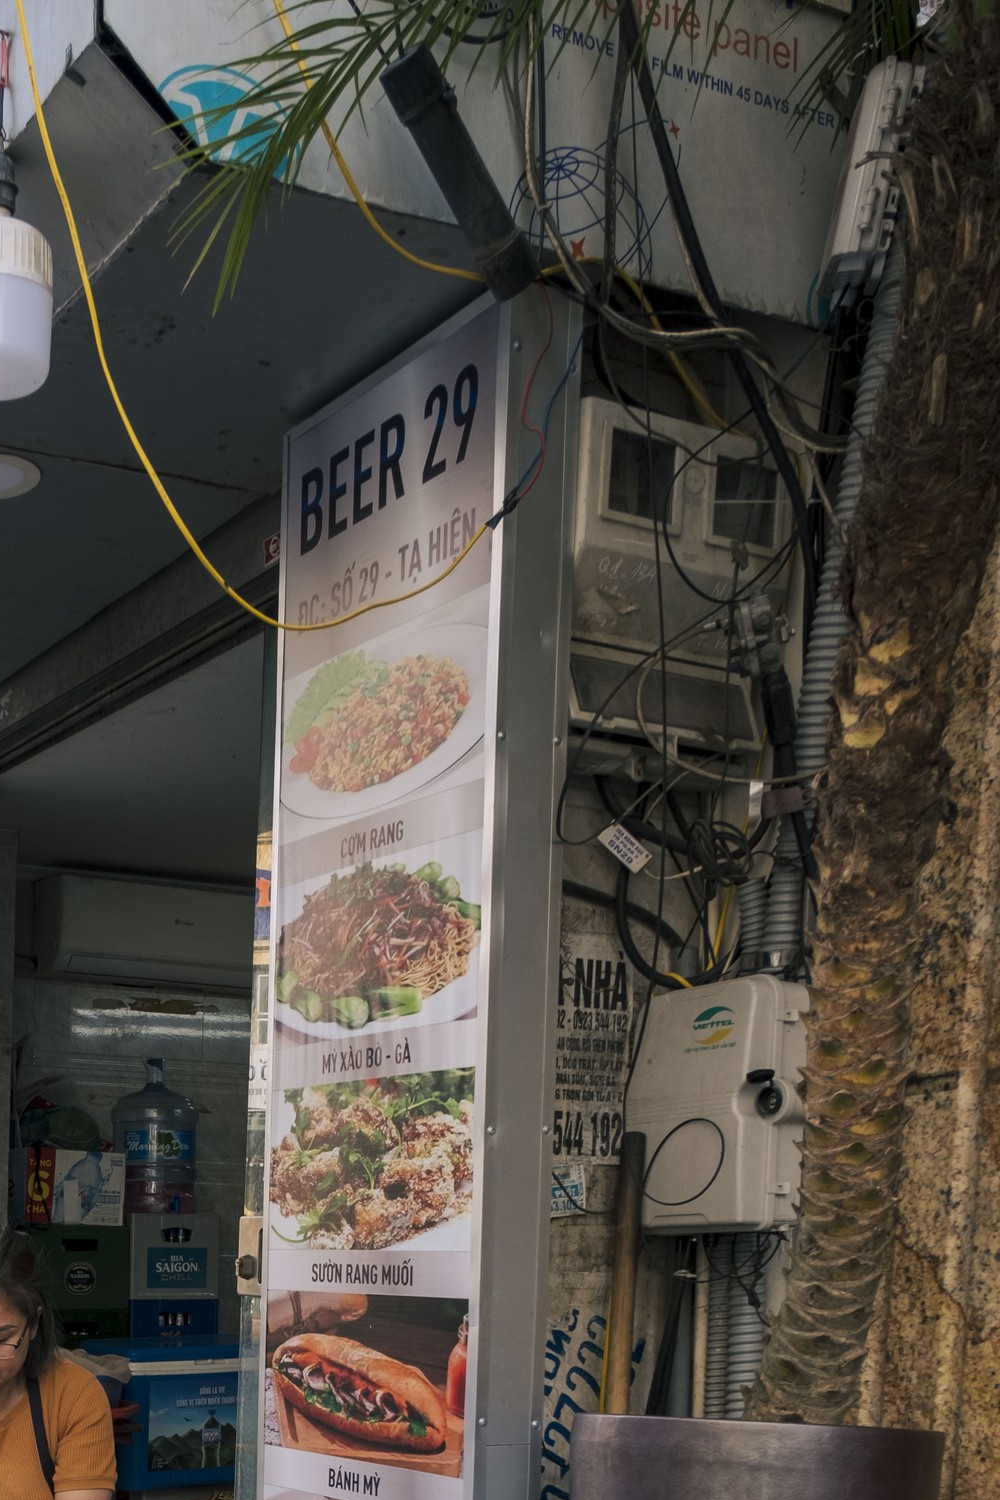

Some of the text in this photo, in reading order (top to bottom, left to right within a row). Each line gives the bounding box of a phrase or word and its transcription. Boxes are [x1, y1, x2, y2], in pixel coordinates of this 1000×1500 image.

[713, 21, 798, 73] panel
[551, 23, 615, 58] REMOVE
[652, 57, 683, 80] FILM
[686, 67, 733, 98] WITHIN
[736, 84, 751, 101] 45
[754, 90, 789, 115] DAYS
[793, 103, 835, 129] AFTER
[300, 363, 479, 556] BEER 29
[331, 560, 357, 617] SỐ
[359, 560, 379, 605] 29
[399, 538, 422, 583] TẠ
[341, 820, 404, 858] CƠM RANG
[608, 840, 633, 864] SN29
[574, 951, 627, 1011] NHÀ
[612, 1014, 627, 1034] 192
[693, 1019, 735, 1030] VIETTEL
[322, 1049, 338, 1074] MỲ
[340, 1044, 363, 1072] XÀO
[365, 1041, 382, 1069] BÒ
[395, 1037, 411, 1065] GÀ
[553, 1110, 623, 1157] 544 192
[28, 1158, 52, 1168] TNG
[27, 1170, 51, 1201] 6
[155, 1262, 198, 1273] SAIGON
[161, 1273, 193, 1281] CHILL
[311, 1258, 414, 1288] SƯỜN RANG MUỐI
[328, 1465, 380, 1497] BÁNH MỲ
